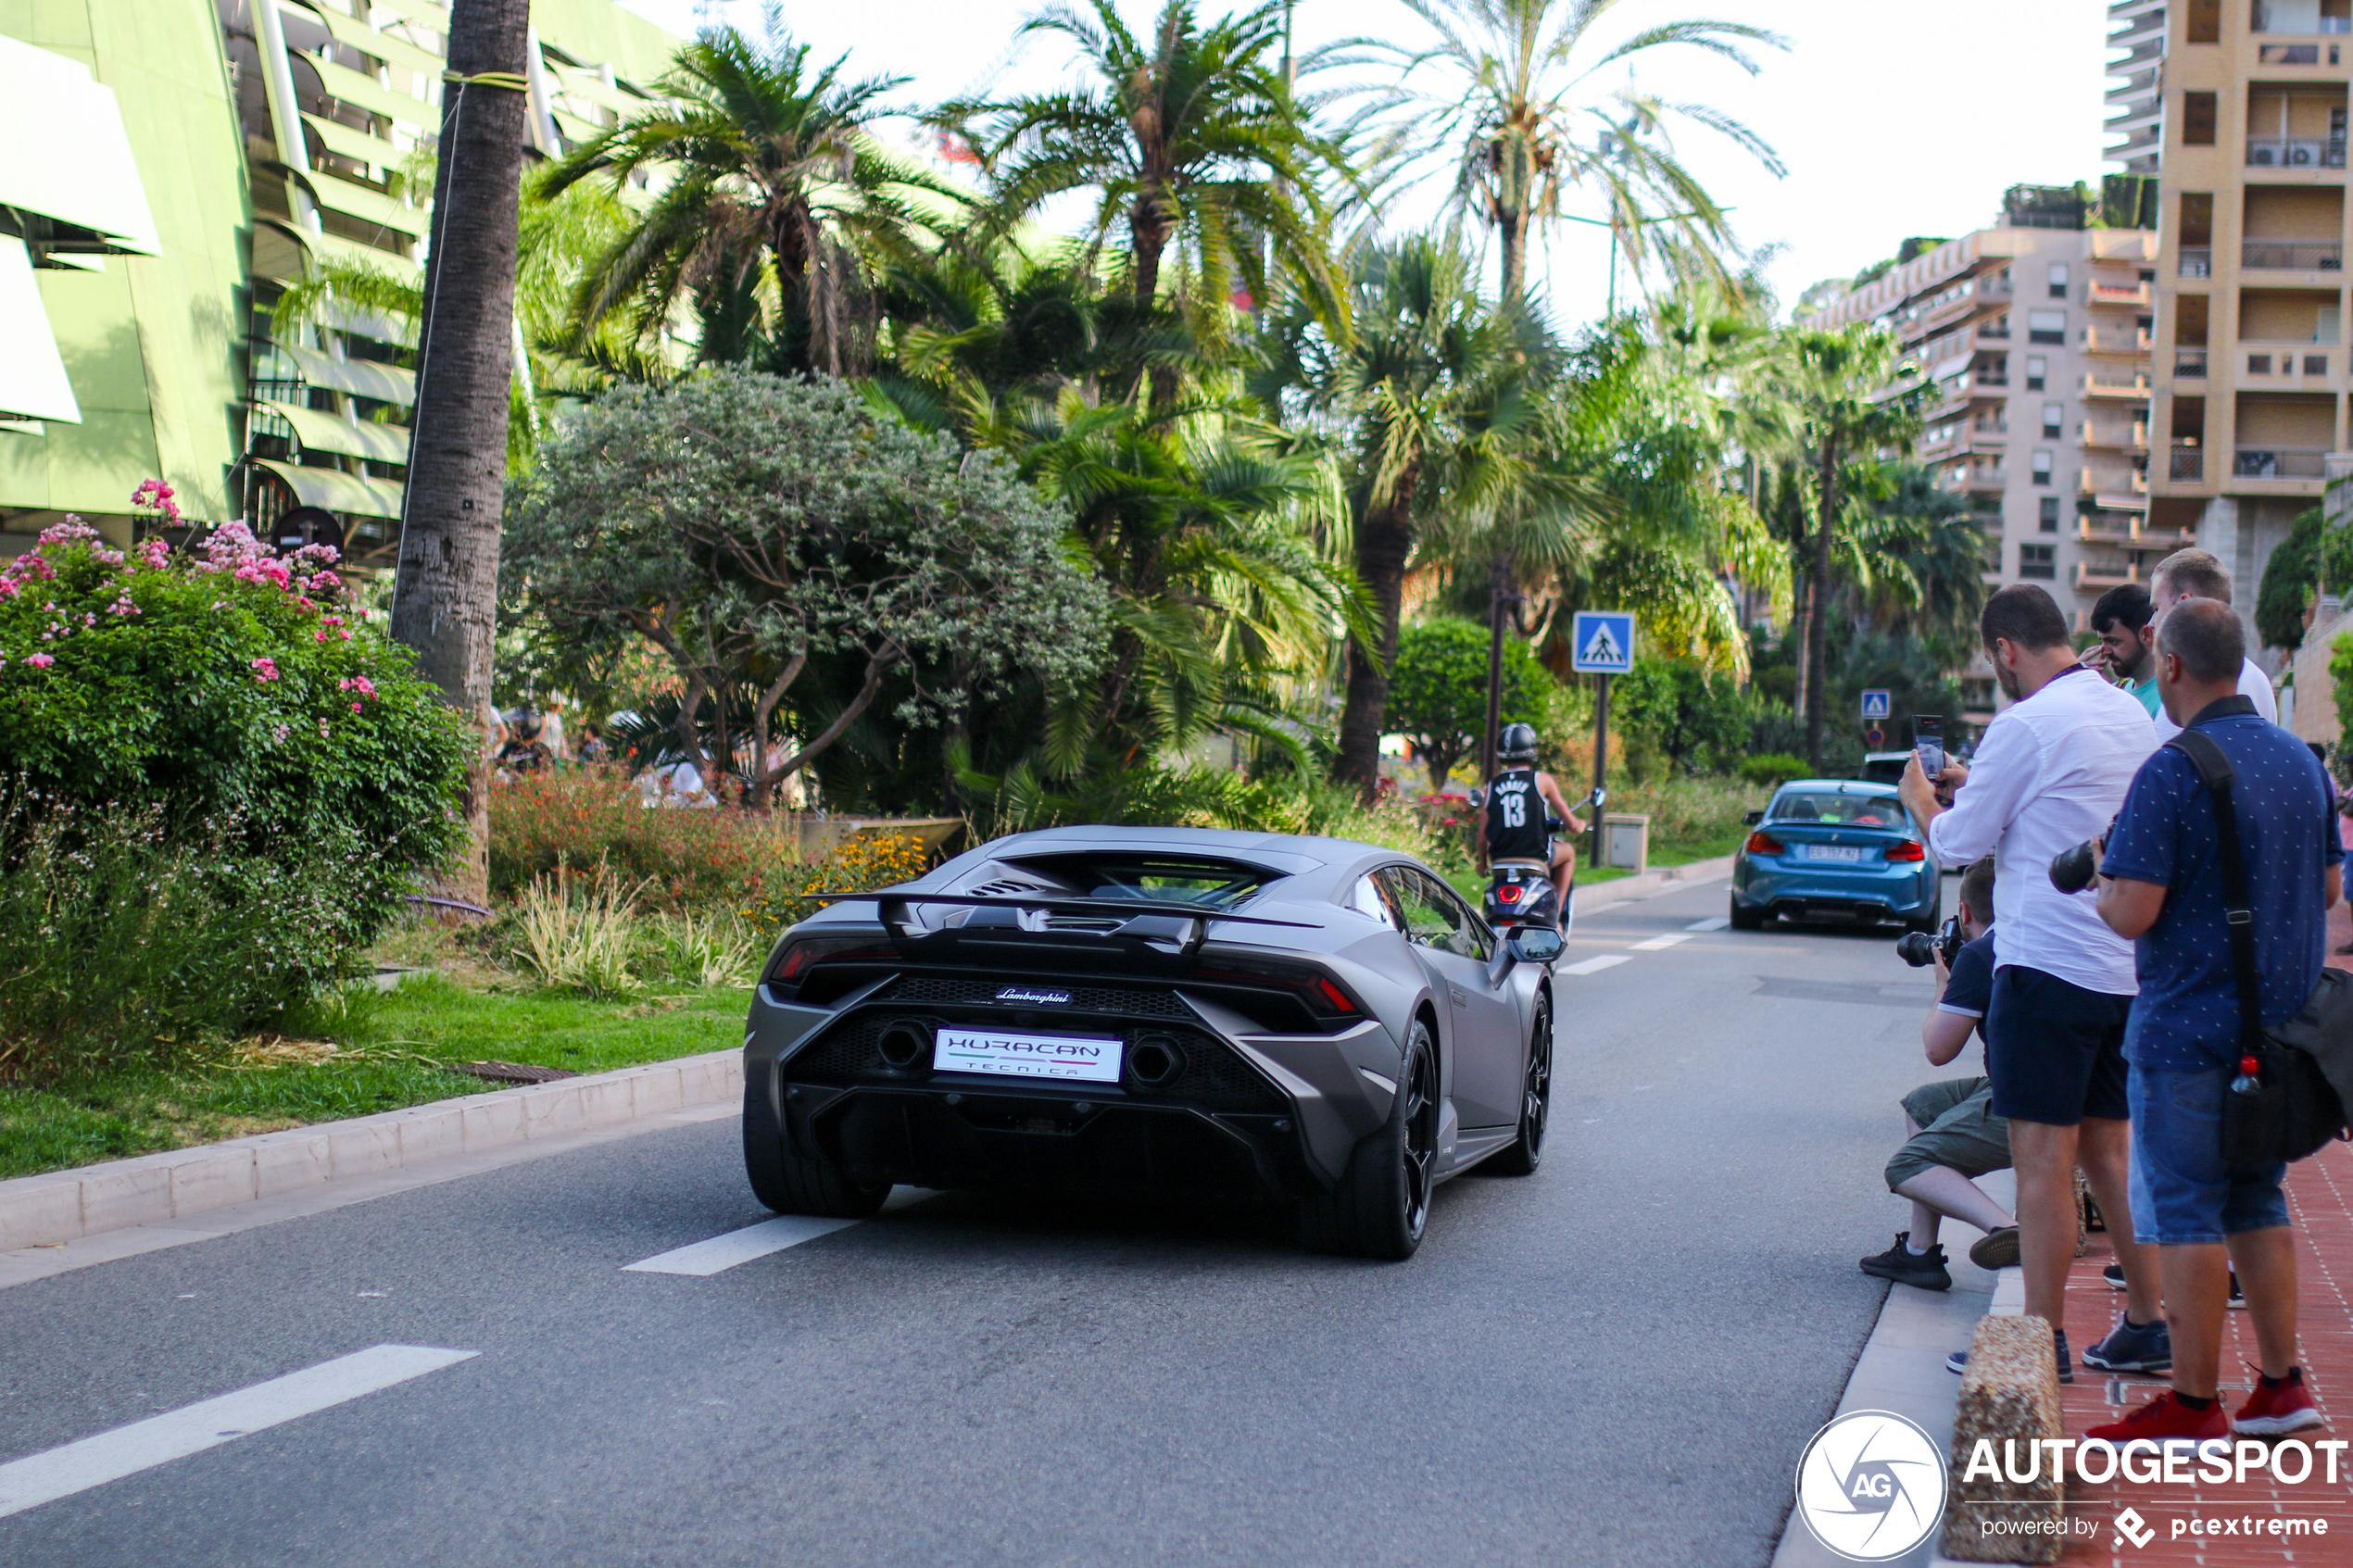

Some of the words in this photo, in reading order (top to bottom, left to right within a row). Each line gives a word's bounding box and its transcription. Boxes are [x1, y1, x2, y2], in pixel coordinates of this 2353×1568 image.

[1500, 794, 1526, 828] 13
[996, 988, 1069, 1004] Lamborghini
[966, 1061, 1078, 1075] TECNICA
